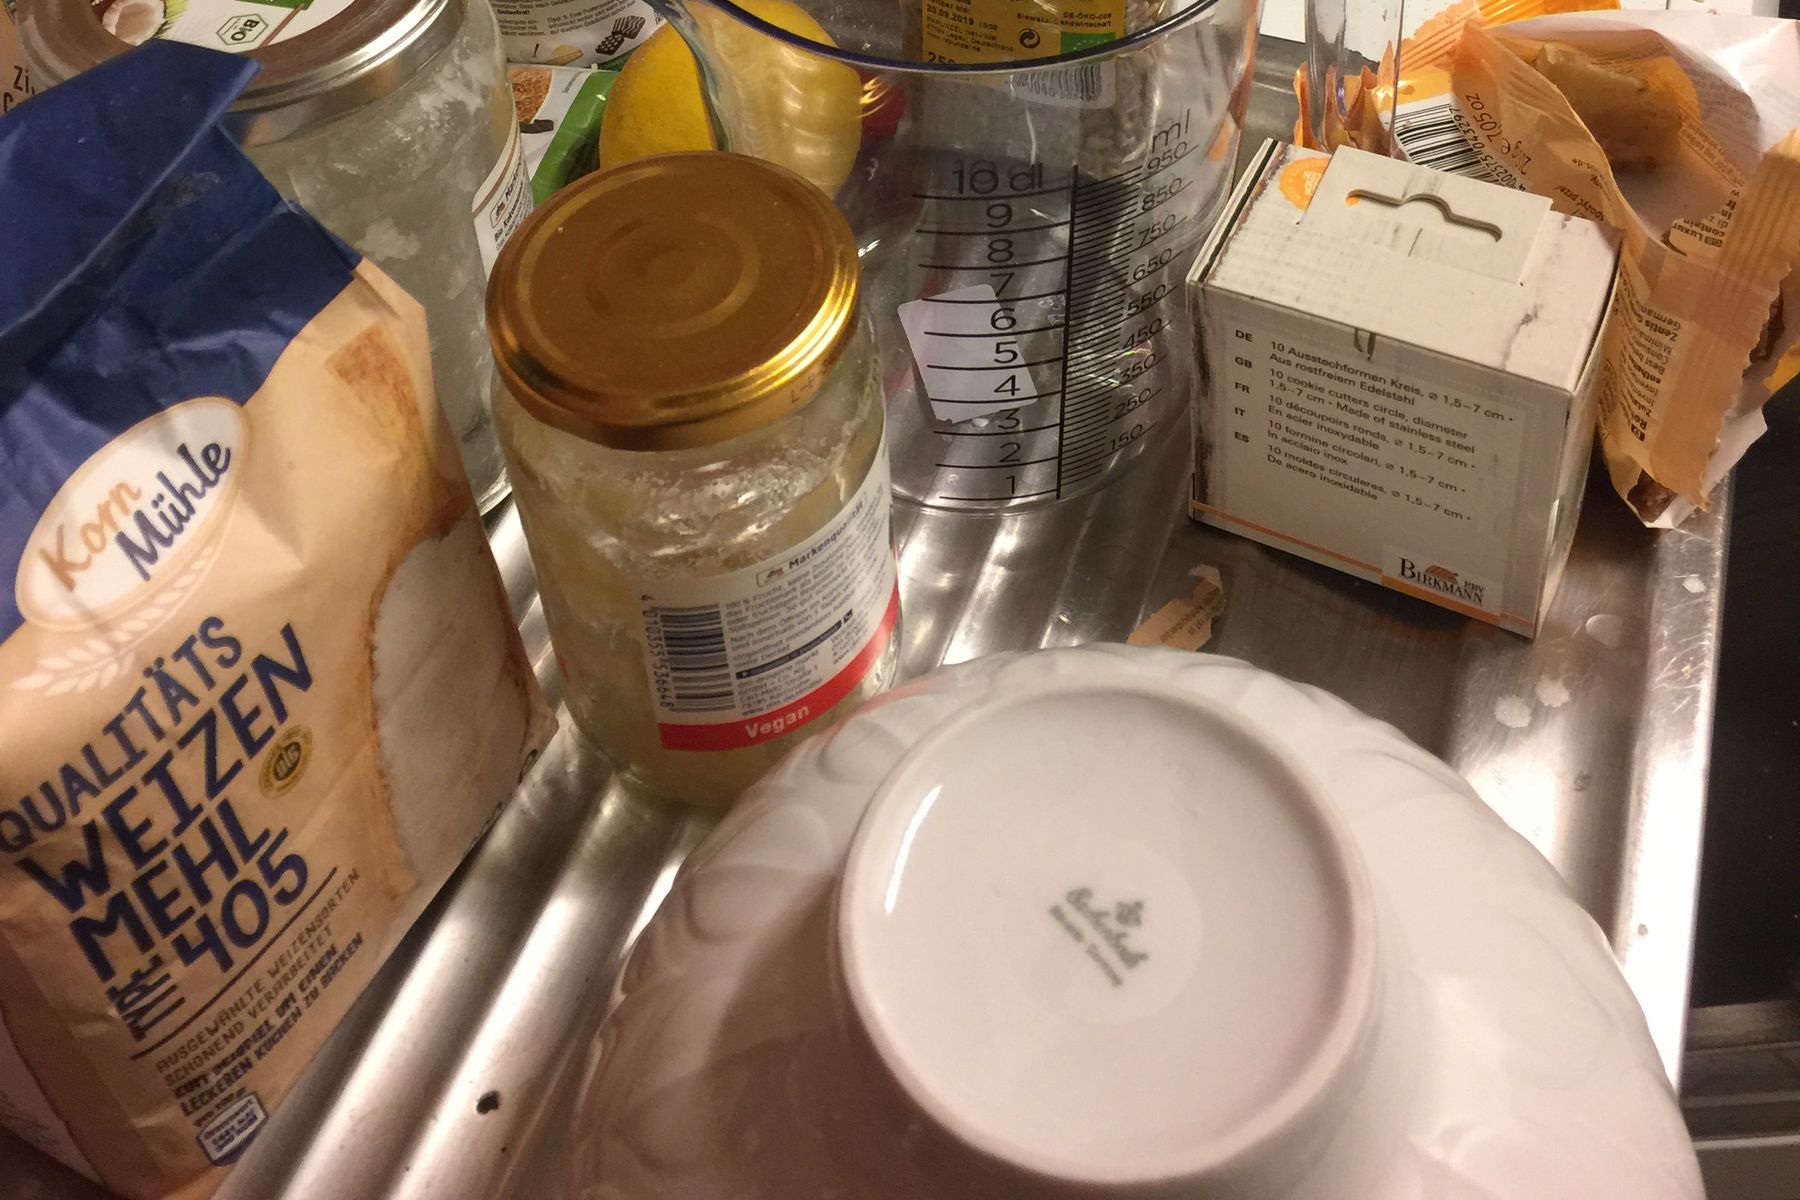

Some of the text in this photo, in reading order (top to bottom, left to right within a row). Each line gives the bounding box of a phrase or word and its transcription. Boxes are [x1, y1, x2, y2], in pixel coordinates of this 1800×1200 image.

[1151, 109, 1191, 152] ml
[1448, 106, 1486, 150] 043297
[1147, 140, 1190, 174] 950
[1141, 176, 1185, 211] 850
[985, 203, 1014, 230] 9
[1137, 213, 1178, 247] 750
[986, 238, 1015, 263] 8
[1131, 247, 1175, 282] 650
[990, 271, 1016, 297] 7
[1126, 282, 1168, 316] 550
[989, 307, 1018, 332] 6
[1122, 316, 1163, 350] 450
[1234, 329, 1253, 343] DE
[1644, 319, 1679, 342] Zentis
[992, 341, 1019, 365] 5
[1118, 352, 1158, 382] 350
[1234, 356, 1253, 369] GB
[993, 374, 1021, 398] 4
[1234, 381, 1251, 394] FR
[1269, 352, 1292, 367] Aus
[1359, 381, 1415, 406] Edelstahl
[1271, 341, 1285, 353] 10
[1287, 347, 1387, 386] Ausstechformen
[1390, 378, 1424, 398] Kreis,
[1484, 409, 1505, 422] cm
[1112, 386, 1152, 415] 250
[1234, 407, 1246, 417] IT
[1269, 368, 1469, 439] 10 cookie cutters circle, diameter
[997, 407, 1021, 430] 3
[1268, 404, 1381, 451] En acier inoxydable
[1268, 394, 1283, 406] 10
[1285, 400, 1350, 429] découpoirs
[1353, 424, 1391, 444] ronds,
[1447, 456, 1468, 468] cm
[1306, 393, 1325, 405] cm
[1336, 400, 1370, 421] Made
[1373, 415, 1386, 425] of
[1389, 420, 1442, 443] stainless
[1446, 438, 1476, 454] steel
[999, 441, 1022, 464] 2
[1108, 422, 1145, 452] 150
[1234, 431, 1250, 444] ES
[1267, 429, 1348, 466] In acciaio inox
[1268, 419, 1282, 431] 10
[1285, 425, 1329, 448] formine
[1331, 443, 1382, 468] circolari,
[1437, 480, 1458, 493] cm
[1004, 474, 1017, 495] 1
[1267, 454, 1378, 501] De acero inoxidable
[1267, 444, 1282, 456] 10
[1284, 452, 1326, 473] moldes
[1328, 467, 1388, 496] circulares,
[1443, 507, 1463, 520] cm
[113, 439, 231, 582] Mühle
[38, 478, 143, 593] Korn
[0, 615, 242, 853] QUALITÄTS
[744, 705, 810, 738] Vegan
[15, 622, 313, 914] WEIZEN
[69, 798, 272, 984] MEHL
[170, 826, 310, 974] 405
[155, 867, 360, 1075] AUSGEWÄHLTE WEIZENSORTEN
[298, 943, 338, 993] EINEN
[163, 924, 333, 1088] SCHONEND VERARBEITET
[180, 1056, 254, 1117] LECKEREN
